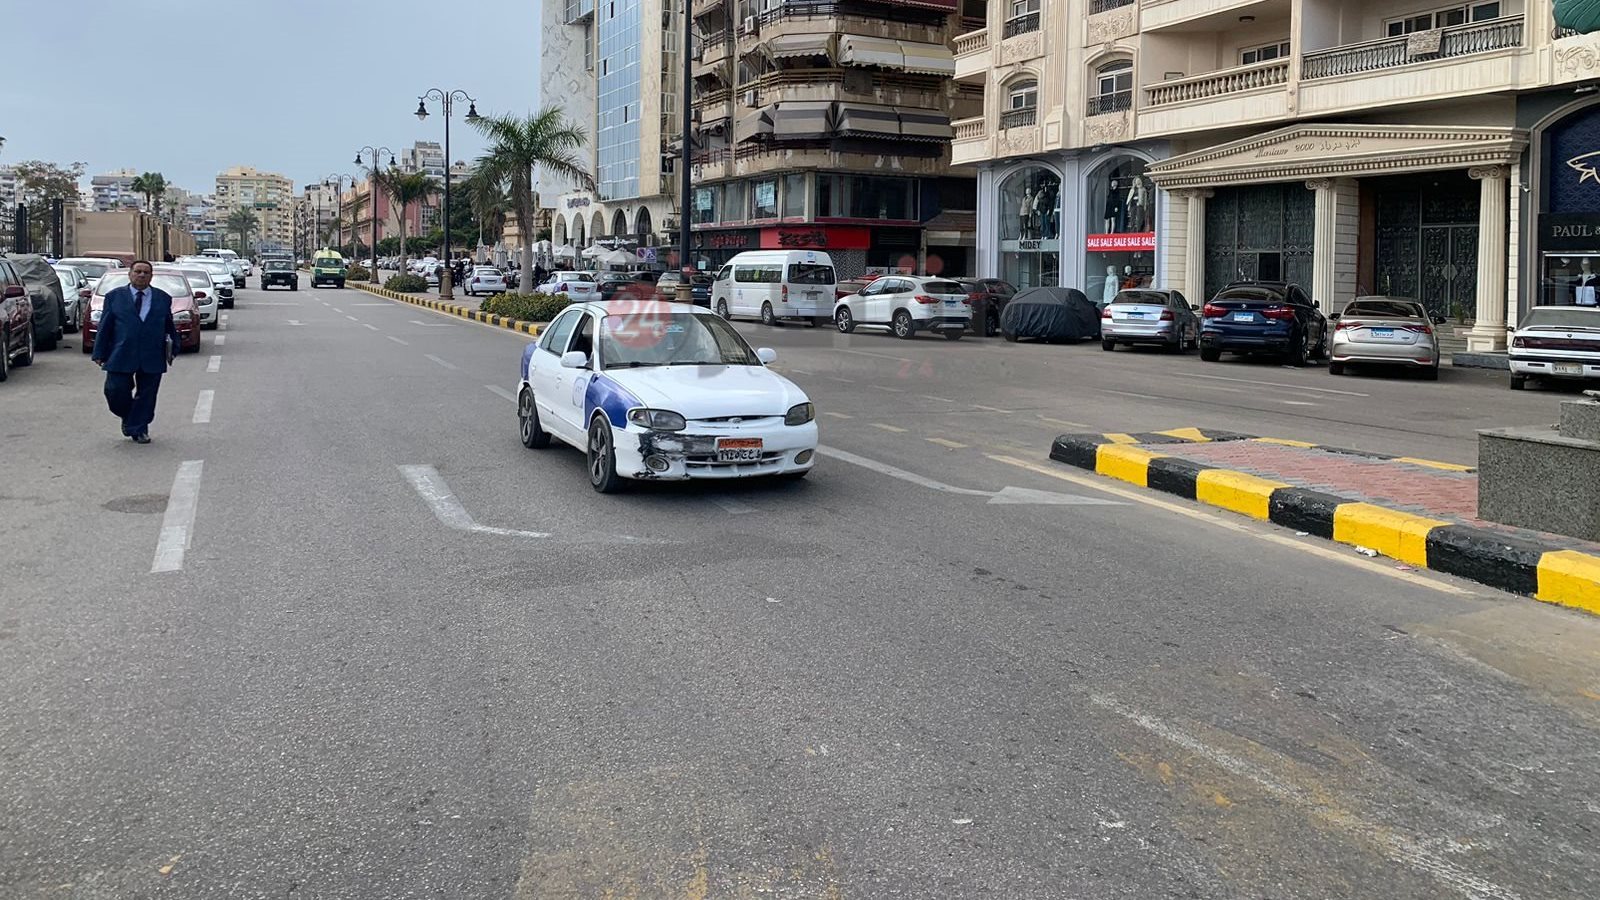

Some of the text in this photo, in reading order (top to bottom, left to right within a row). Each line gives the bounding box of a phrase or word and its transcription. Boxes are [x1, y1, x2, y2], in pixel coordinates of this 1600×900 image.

[1551, 224, 1592, 237] PAUL
[1019, 240, 1041, 249] MIDEY
[1087, 237, 1155, 247] SALE SALE SALE SALE SALE
